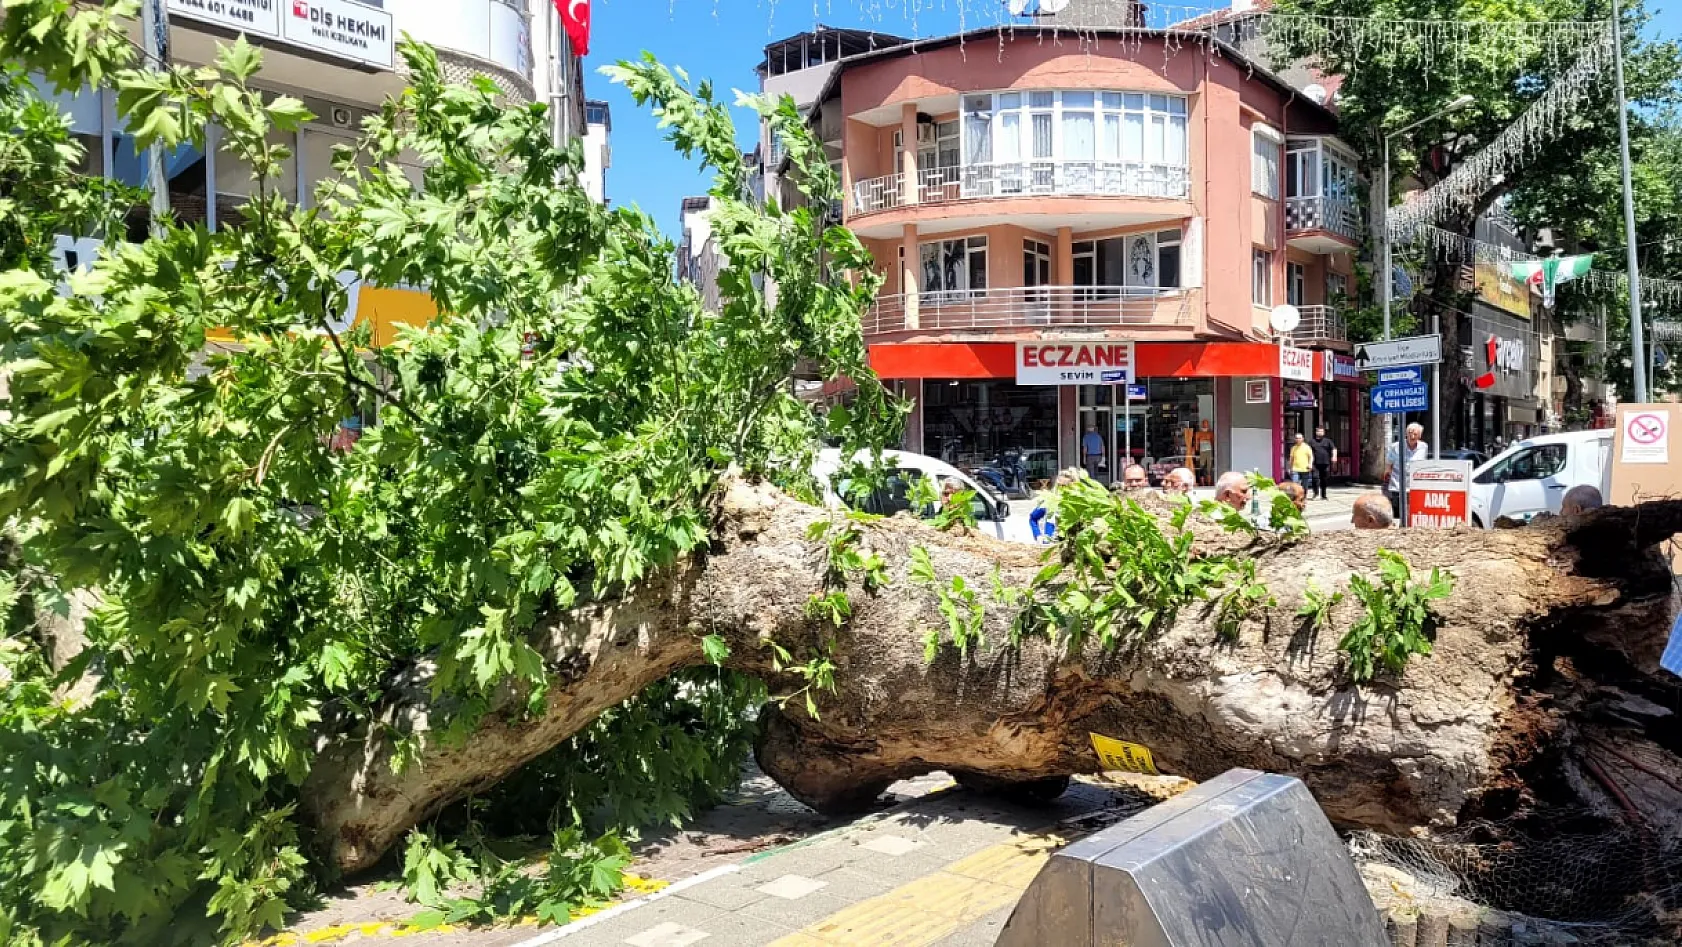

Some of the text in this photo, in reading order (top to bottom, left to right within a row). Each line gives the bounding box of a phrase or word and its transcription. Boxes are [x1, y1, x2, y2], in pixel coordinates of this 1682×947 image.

[310, 7, 385, 42] DİŞ HEKİMİ
[1022, 344, 1129, 367] ECZANE
[1282, 349, 1312, 369] ECZANE
[1060, 369, 1094, 381] SEVİM
[1384, 396, 1425, 409] FEN LİSESİ
[1424, 492, 1451, 512] ARAÇ
